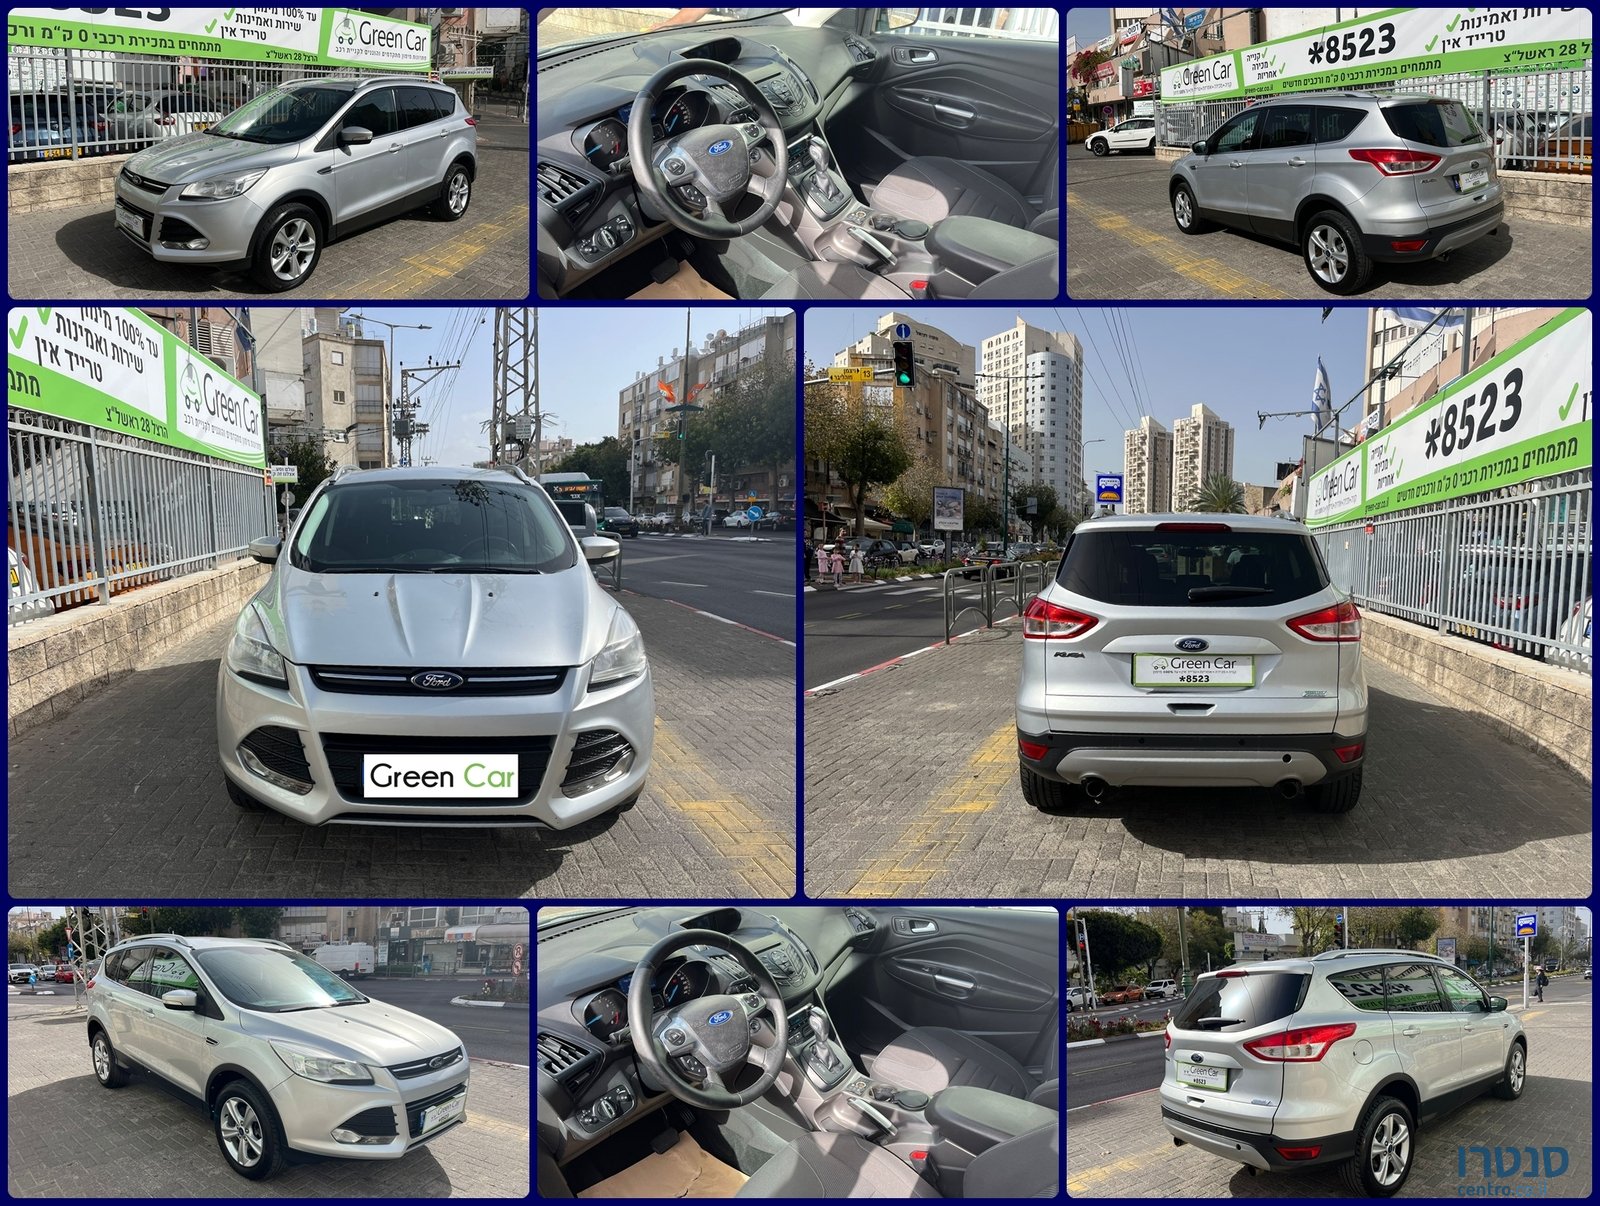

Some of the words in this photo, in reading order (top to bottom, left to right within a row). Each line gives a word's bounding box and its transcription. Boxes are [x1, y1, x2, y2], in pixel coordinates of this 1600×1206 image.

[235, 13, 273, 28] ואמינות
[306, 12, 317, 21] עד
[1460, 8, 1517, 31] ואמינות
[220, 25, 237, 39] אין
[275, 19, 301, 32] שירות
[78, 29, 88, 43] 0
[92, 32, 124, 45] רכבי
[240, 28, 267, 40] טרייד
[359, 21, 403, 49] Green
[405, 29, 427, 52] Car
[1466, 29, 1506, 46] טרייד
[128, 36, 175, 48] במכירת
[178, 39, 222, 52] מתמחים
[1441, 36, 1461, 53] אין
[1559, 43, 1577, 56] 28
[303, 54, 318, 62] הרצל
[1182, 67, 1211, 86] Green
[1212, 60, 1232, 81] Car
[1251, 61, 1269, 71] מכירה
[1365, 66, 1398, 78] במכירת
[1400, 59, 1442, 73] מתמחים
[1257, 70, 1277, 80] אחריות
[1303, 76, 1324, 86] ורכבים
[1340, 72, 1346, 82] 0
[1347, 71, 1364, 80] רכבי
[1244, 84, 1274, 95] green-car.co.il
[1282, 80, 1302, 89] חדשים
[55, 311, 109, 357] ואמינות
[115, 315, 145, 351] 100%
[34, 336, 61, 367] אין
[145, 337, 159, 358] עד
[110, 342, 144, 374] שירות
[64, 348, 103, 383] טרייד
[863, 370, 871, 378] 13
[203, 372, 243, 429] Green
[242, 397, 259, 436] Car
[140, 416, 151, 434] 28
[152, 419, 168, 439] הרצל
[1522, 436, 1578, 470] מתמחים
[1479, 456, 1519, 482] במכירת
[1322, 474, 1343, 501] Green
[1343, 461, 1359, 492] Car
[1453, 474, 1458, 489] 0
[1459, 468, 1478, 485] רכבי
[1396, 487, 1415, 503] חדשים
[1415, 480, 1436, 498] ורכבים
[1182, 640, 1201, 649] Ford
[1170, 657, 1211, 669] Green
[1214, 657, 1237, 669] Car
[422, 674, 452, 687] Ford
[1190, 1065, 1207, 1076] Green
[1208, 1068, 1219, 1077] Car
